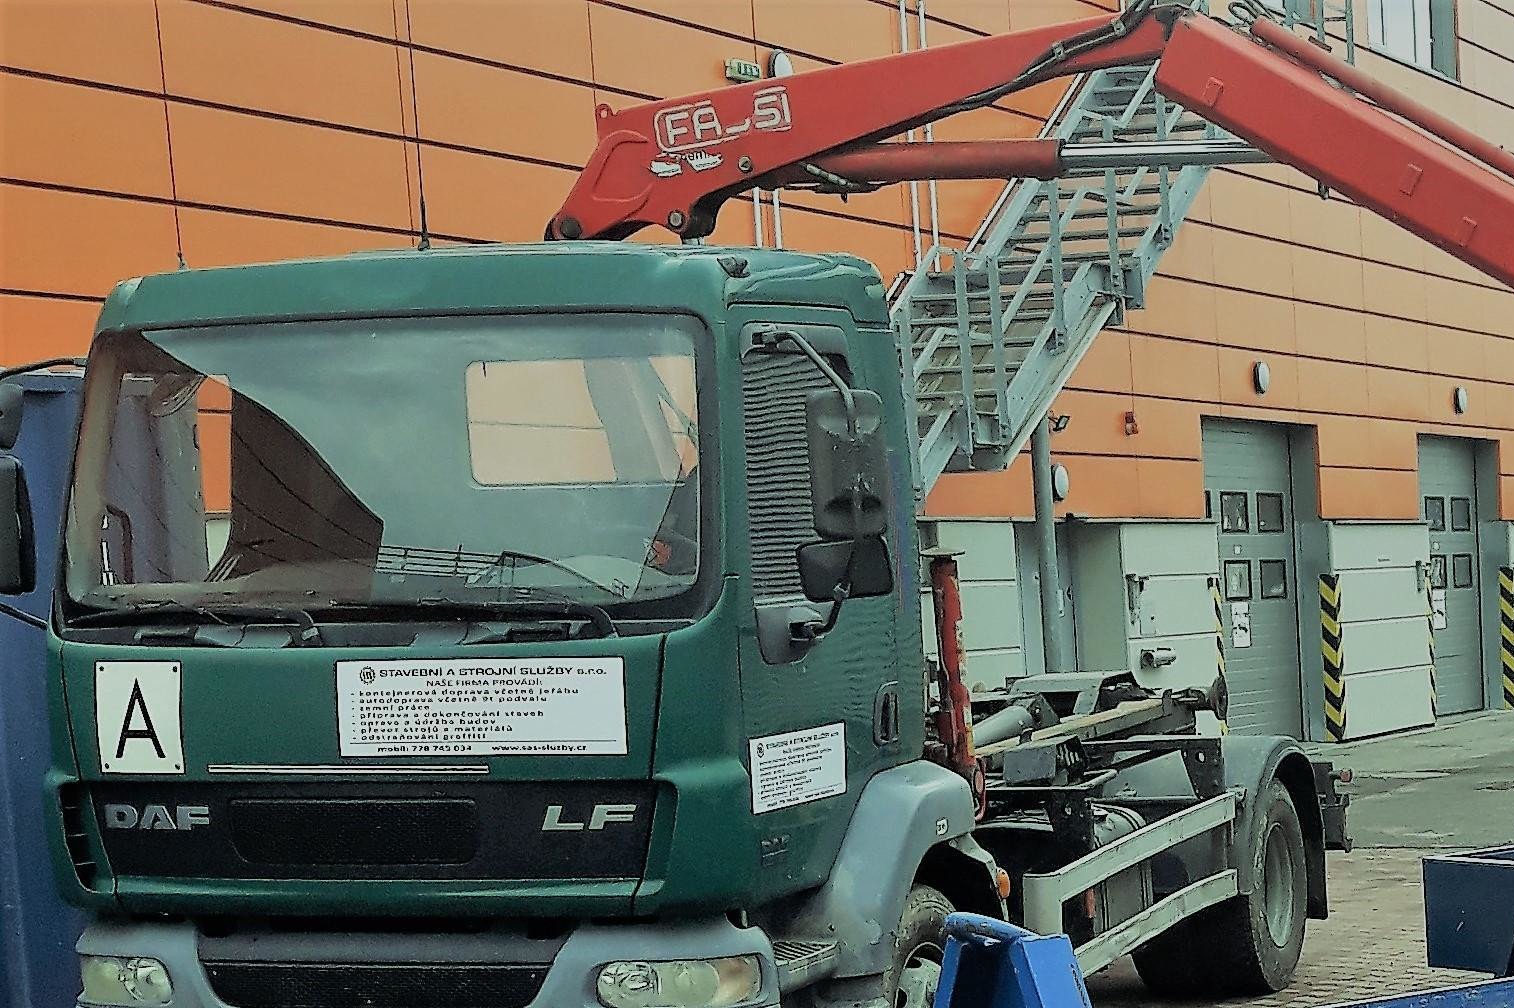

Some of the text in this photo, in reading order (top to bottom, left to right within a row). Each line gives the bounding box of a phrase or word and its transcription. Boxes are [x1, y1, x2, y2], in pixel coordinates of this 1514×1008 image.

[446, 668, 455, 676] A
[459, 666, 517, 676] STROJNÍ
[520, 665, 574, 675] SLUŽBY
[115, 677, 167, 759] A
[104, 803, 210, 831] DAF
[541, 804, 637, 831] LF
